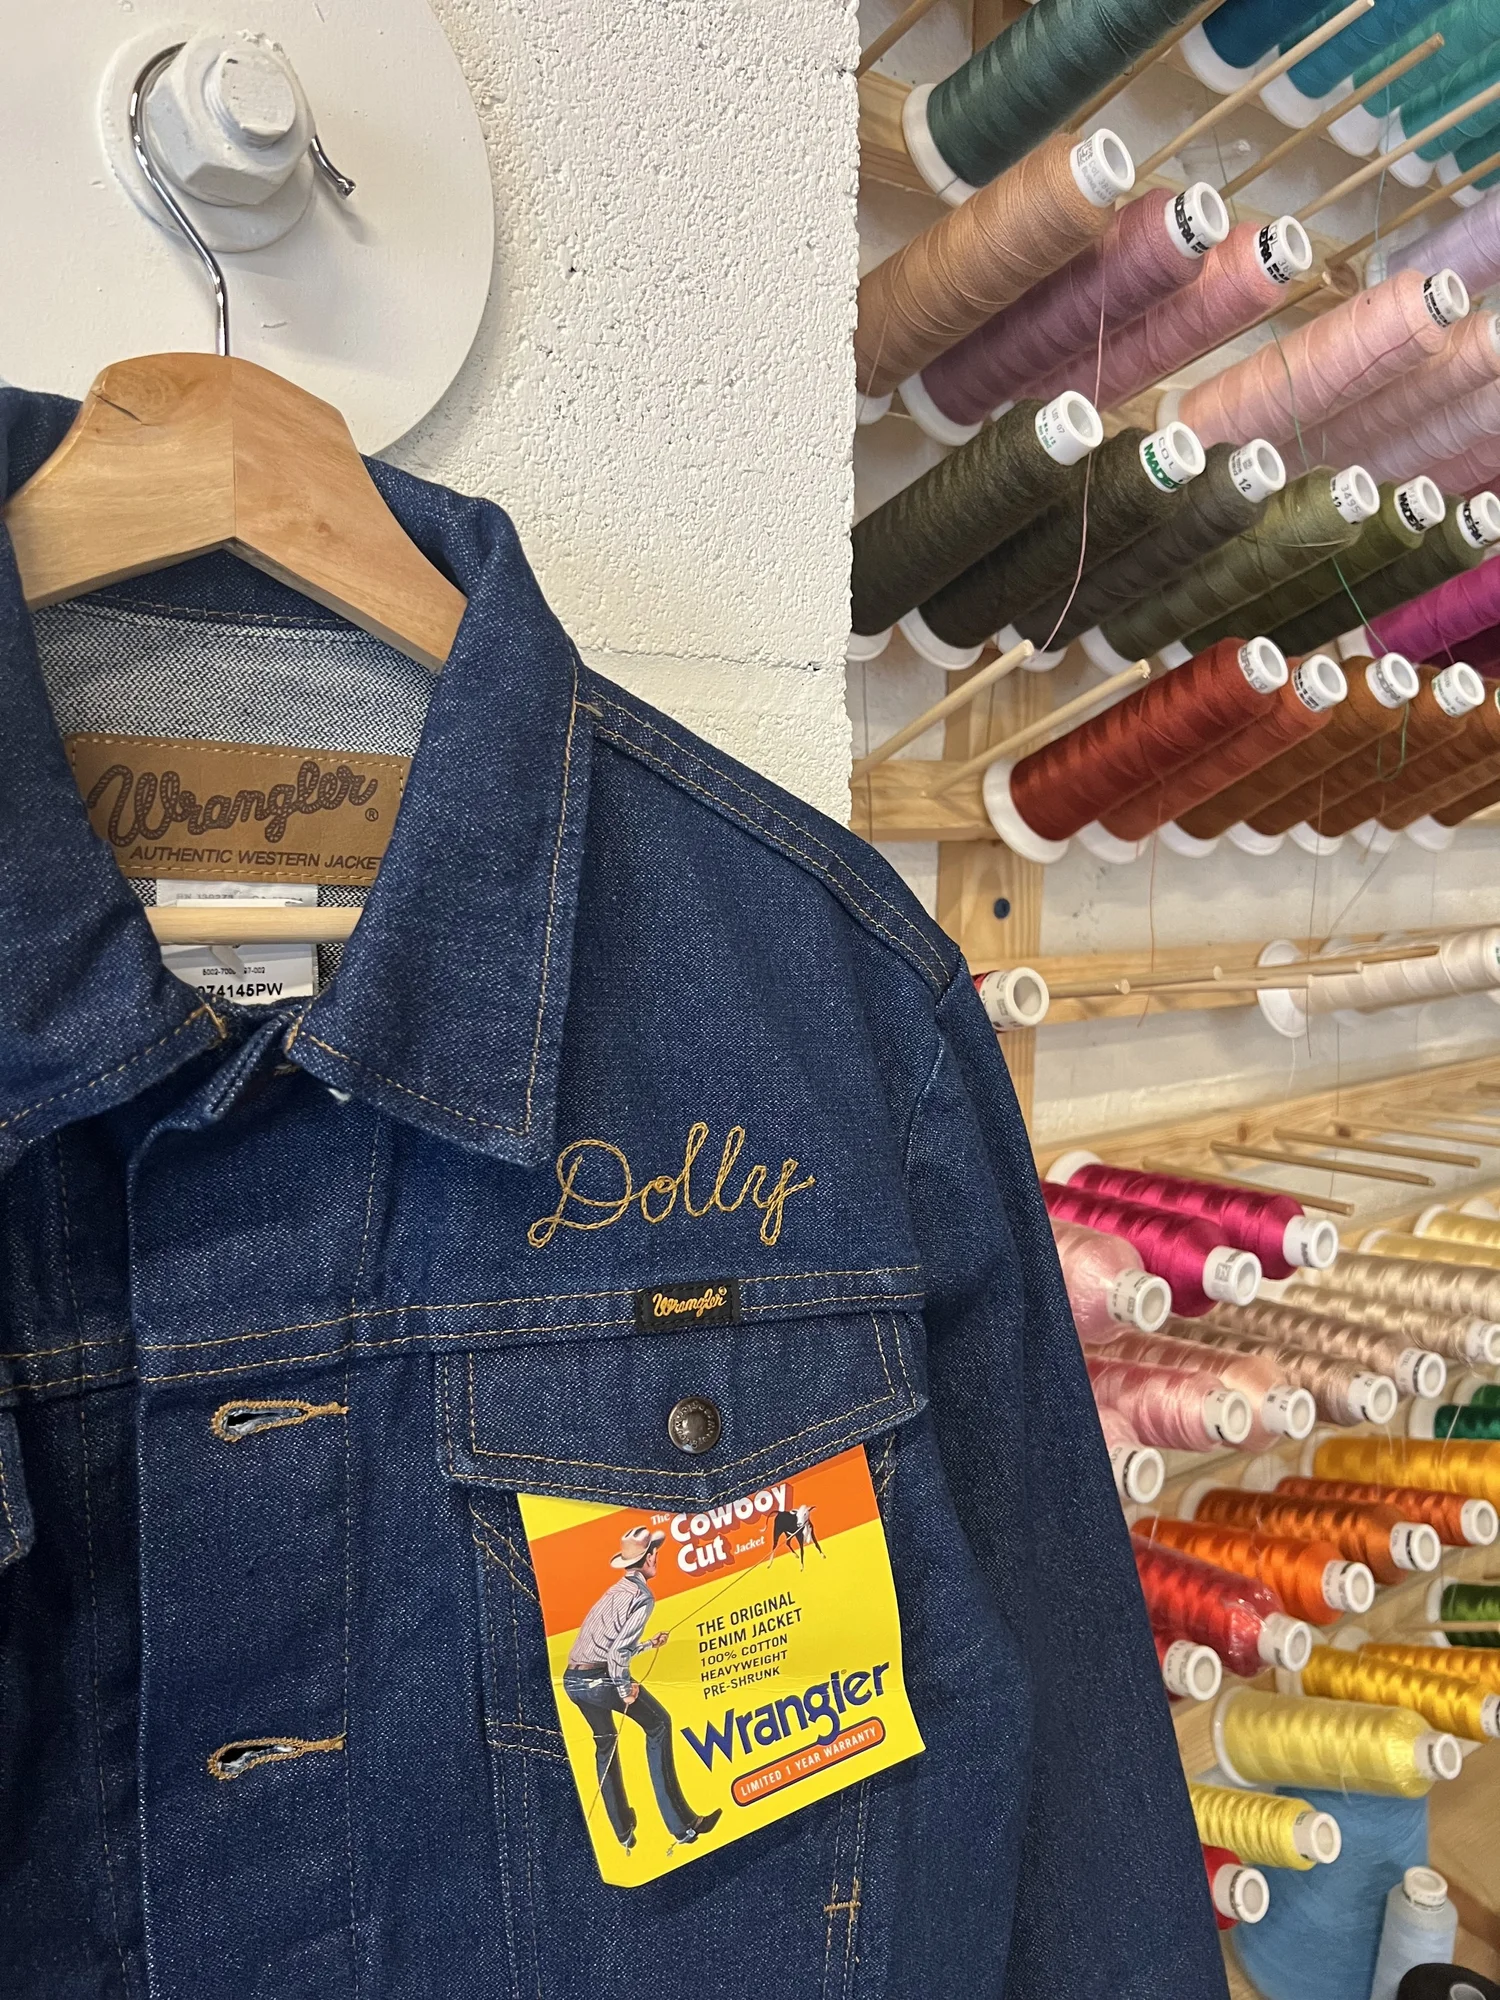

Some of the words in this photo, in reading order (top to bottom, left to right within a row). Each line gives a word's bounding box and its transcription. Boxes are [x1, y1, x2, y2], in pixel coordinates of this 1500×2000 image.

[1158, 436, 1174, 470] COL
[1238, 478, 1252, 492] 12
[87, 760, 378, 848] Wrangler
[130, 846, 233, 863] AUTHENTIC
[238, 849, 321, 867] WESTERN
[324, 854, 381, 871] JACKE
[527, 1121, 816, 1248] Dolly
[652, 1287, 726, 1318] Wrangler
[650, 1513, 671, 1526] The
[670, 1482, 789, 1543] Cowboy
[677, 1534, 728, 1573] Cut
[733, 1535, 766, 1555] Jacket
[696, 1615, 726, 1637] THE
[730, 1591, 796, 1626] ORIGINAL
[699, 1628, 747, 1654] DENIM
[751, 1607, 802, 1638] JACKET
[701, 1649, 738, 1667] 100%
[741, 1634, 788, 1656] COTTON
[701, 1650, 788, 1682] HEAVYWEIGHT
[703, 1666, 781, 1700] PRE-SHRUNK
[680, 1661, 889, 1773] Wrangler
[740, 1769, 783, 1798] LIMITED
[785, 1764, 792, 1776] 1
[794, 1752, 823, 1771] YEAR
[822, 1726, 877, 1758] WARRANTY
